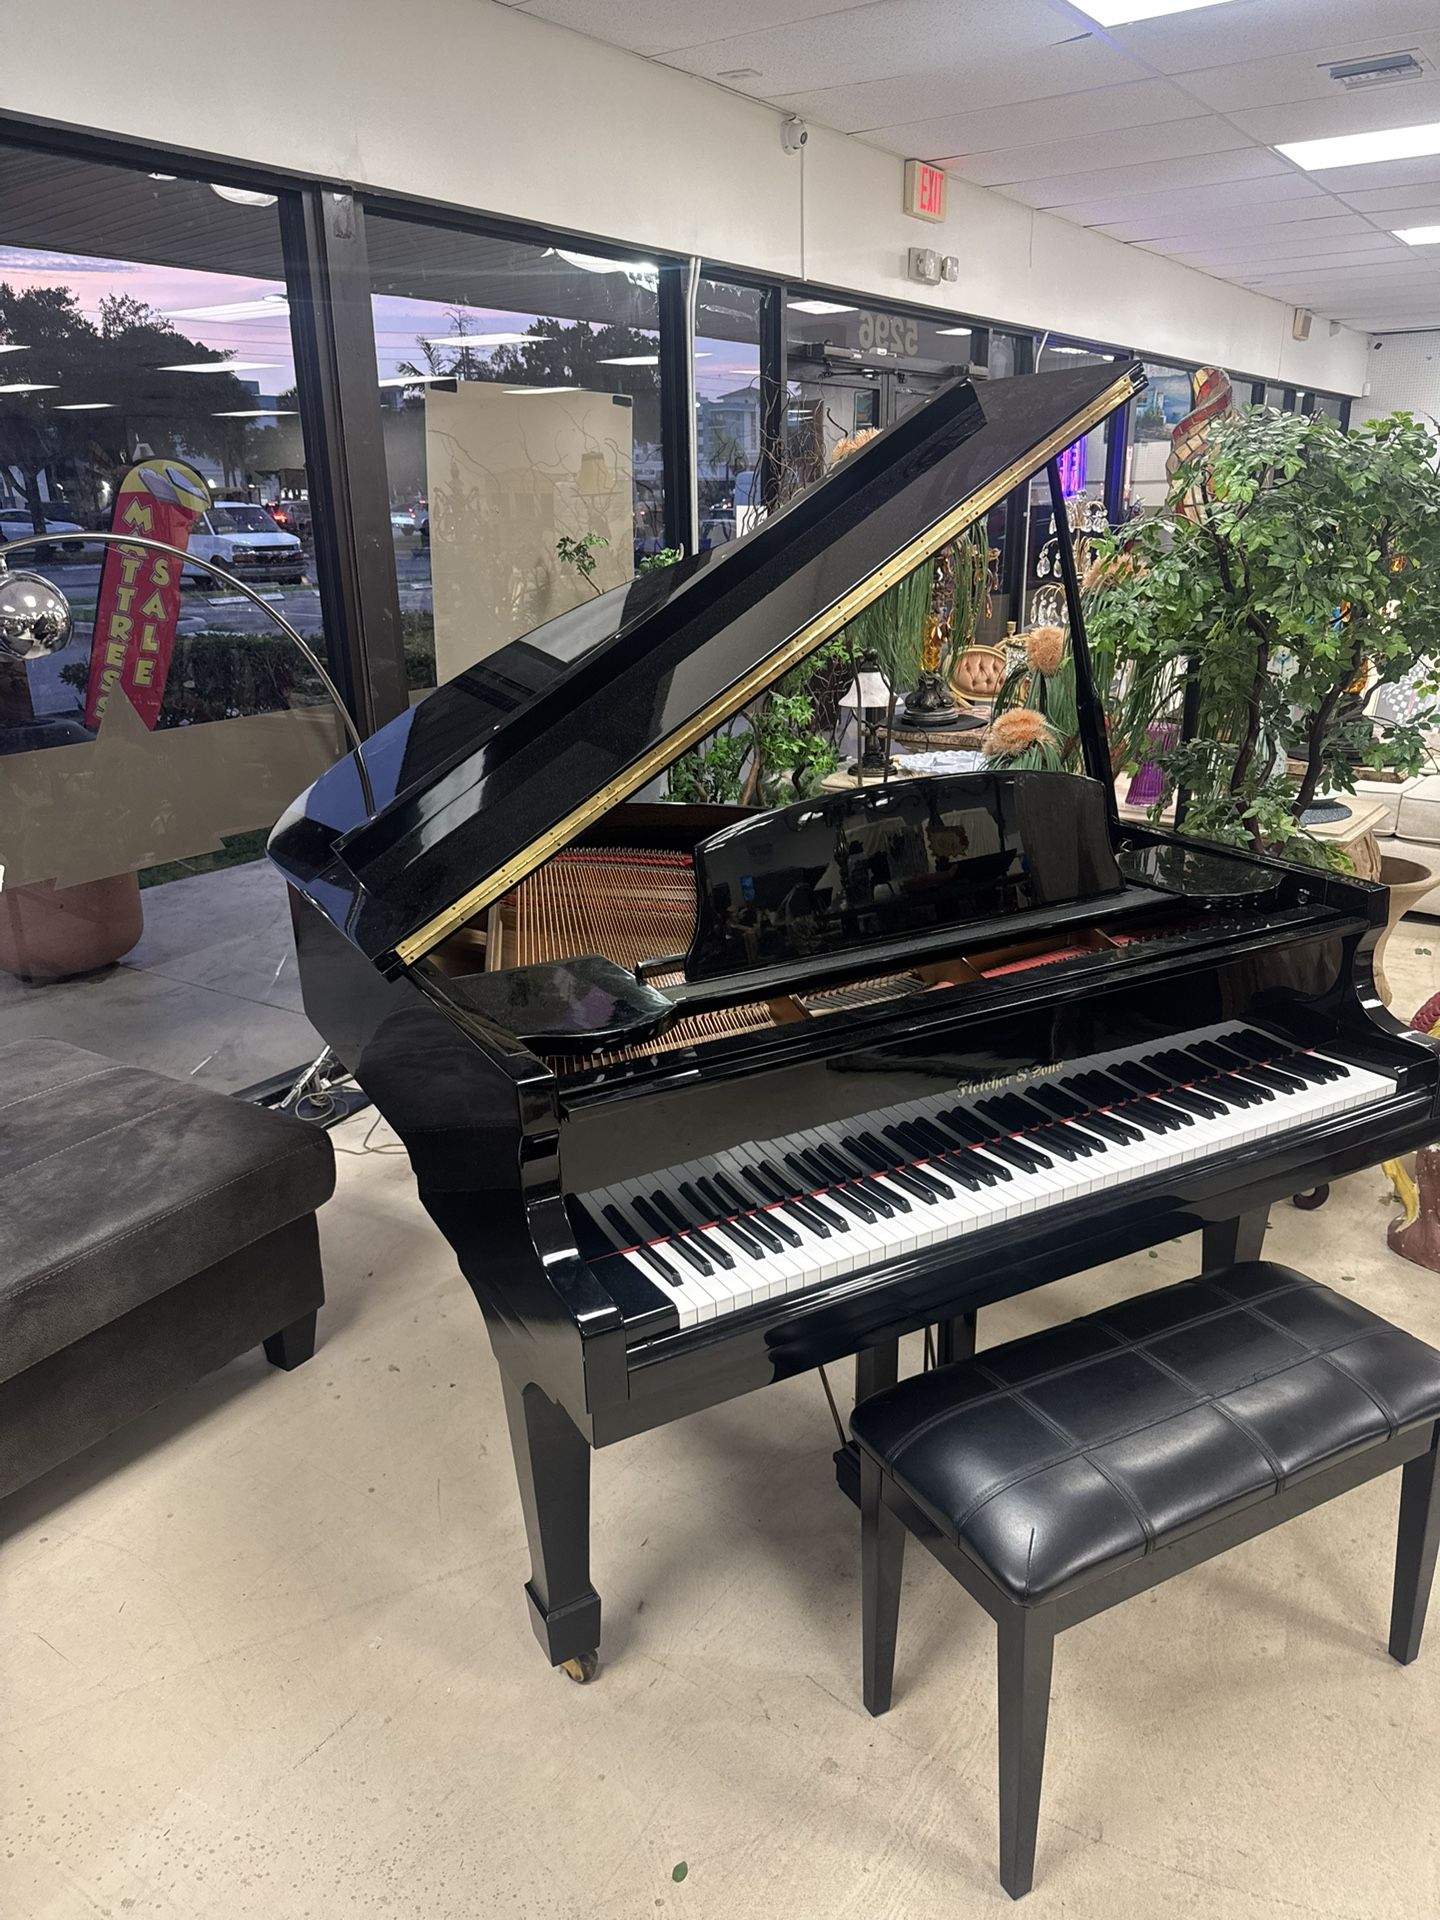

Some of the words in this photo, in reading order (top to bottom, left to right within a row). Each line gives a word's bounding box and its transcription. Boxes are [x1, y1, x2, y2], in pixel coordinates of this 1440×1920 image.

[919, 166, 944, 216] EXIT
[132, 557, 170, 688] SALE
[957, 1073, 1013, 1099] Fletcher
[1016, 1066, 1028, 1083] &
[1031, 1060, 1064, 1080] Sons
